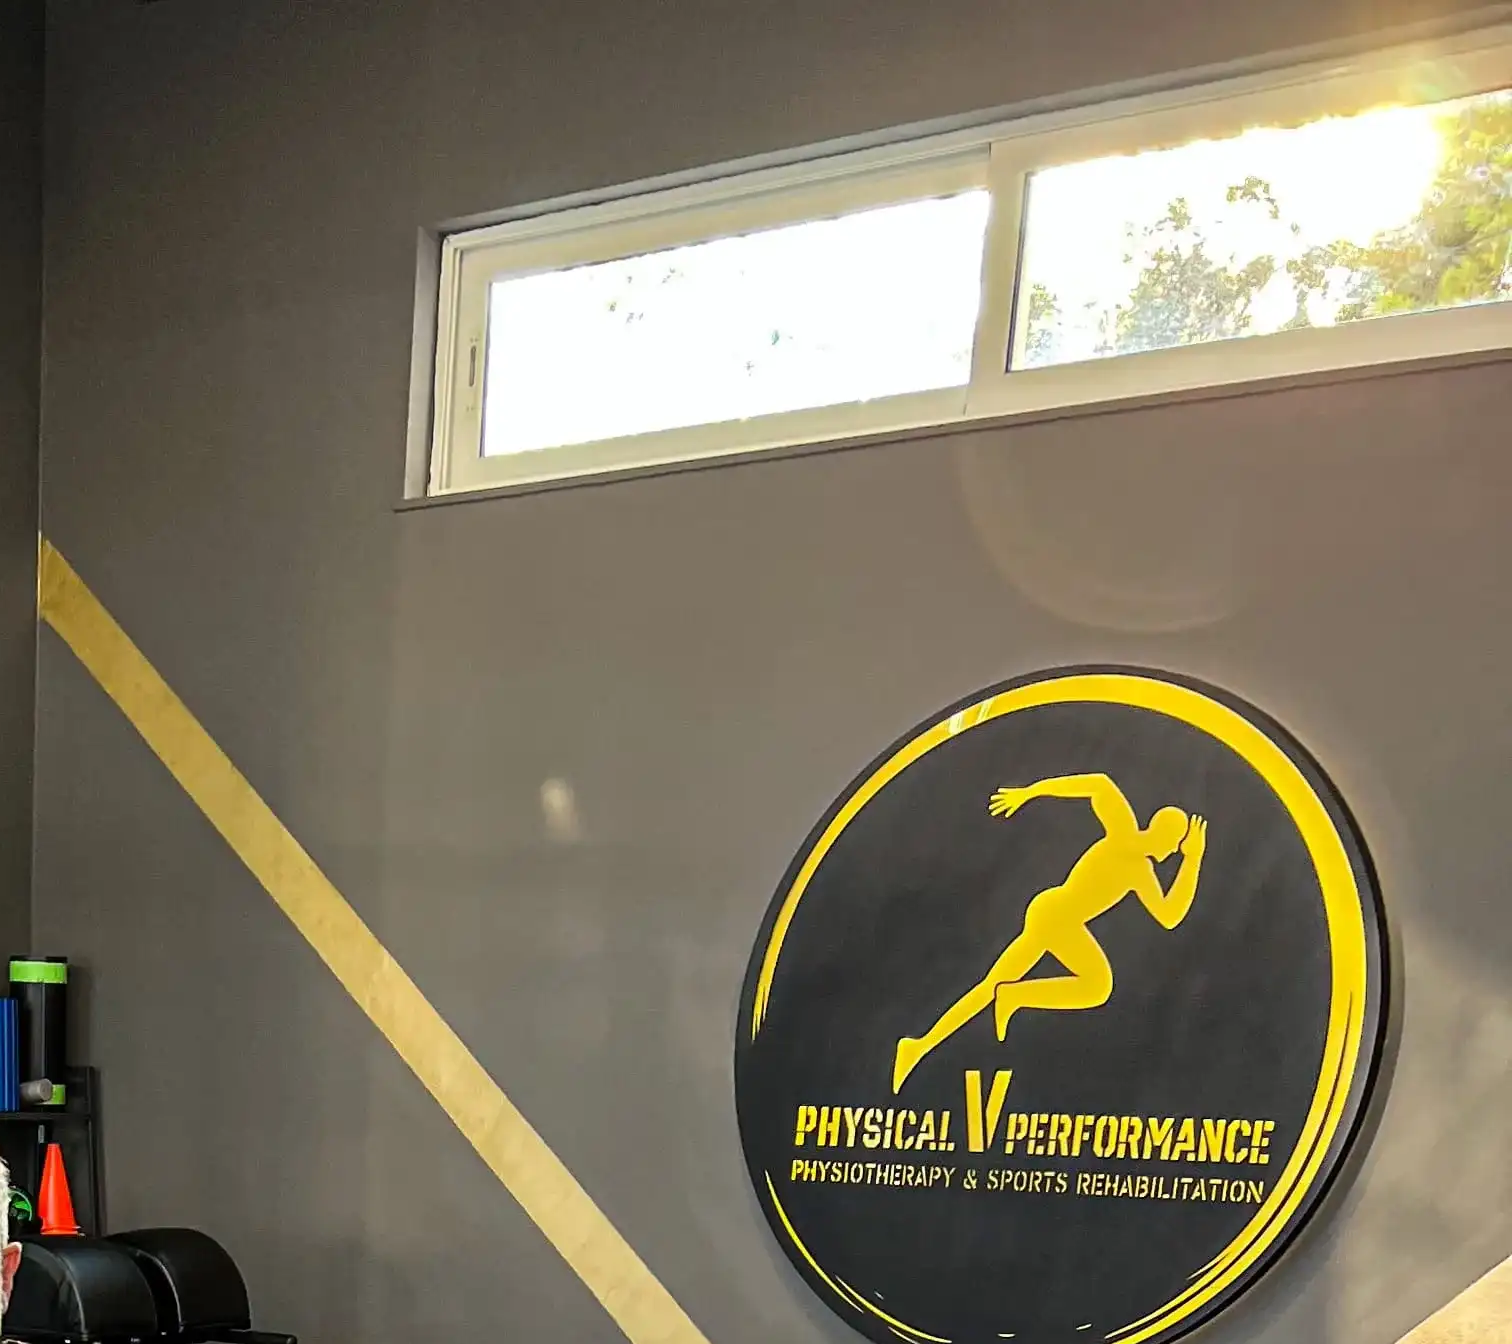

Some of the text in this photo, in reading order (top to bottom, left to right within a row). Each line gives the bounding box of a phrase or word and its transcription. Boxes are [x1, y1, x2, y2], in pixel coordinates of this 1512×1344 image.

[795, 1069, 1275, 1164] PHYSICAL V PERFORMANCE
[791, 1159, 1265, 1204] PHYSIOTHERAPY & SPORTS REHABILITATION
